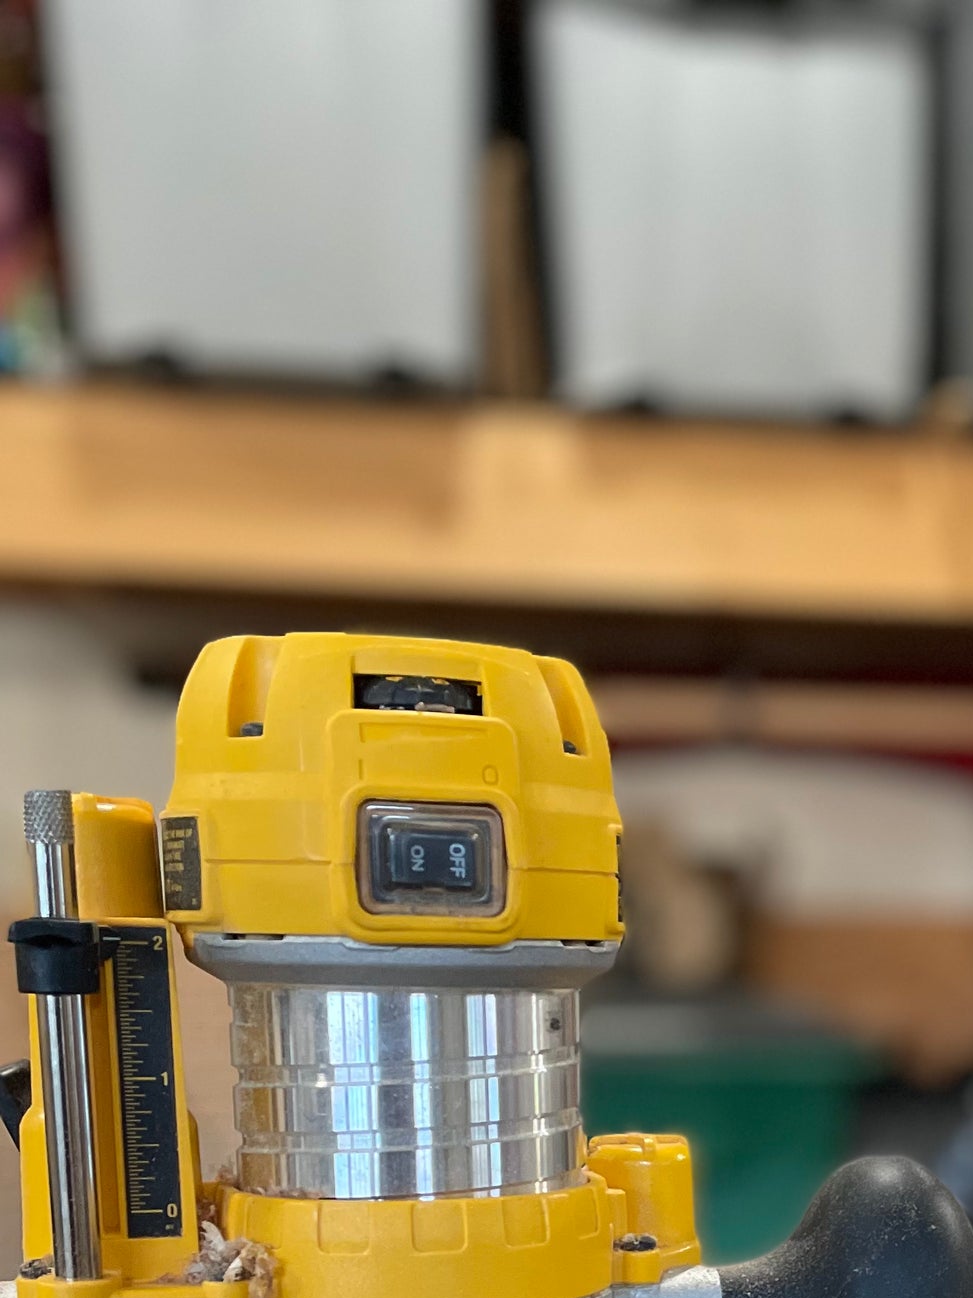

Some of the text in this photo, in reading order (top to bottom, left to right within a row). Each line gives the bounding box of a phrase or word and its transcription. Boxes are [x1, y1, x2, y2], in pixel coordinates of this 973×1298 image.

[410, 845, 425, 872] ON
[449, 843, 466, 879] OFF
[152, 935, 164, 951] 2
[160, 1071, 169, 1087] 1
[166, 1203, 178, 1218] 0
